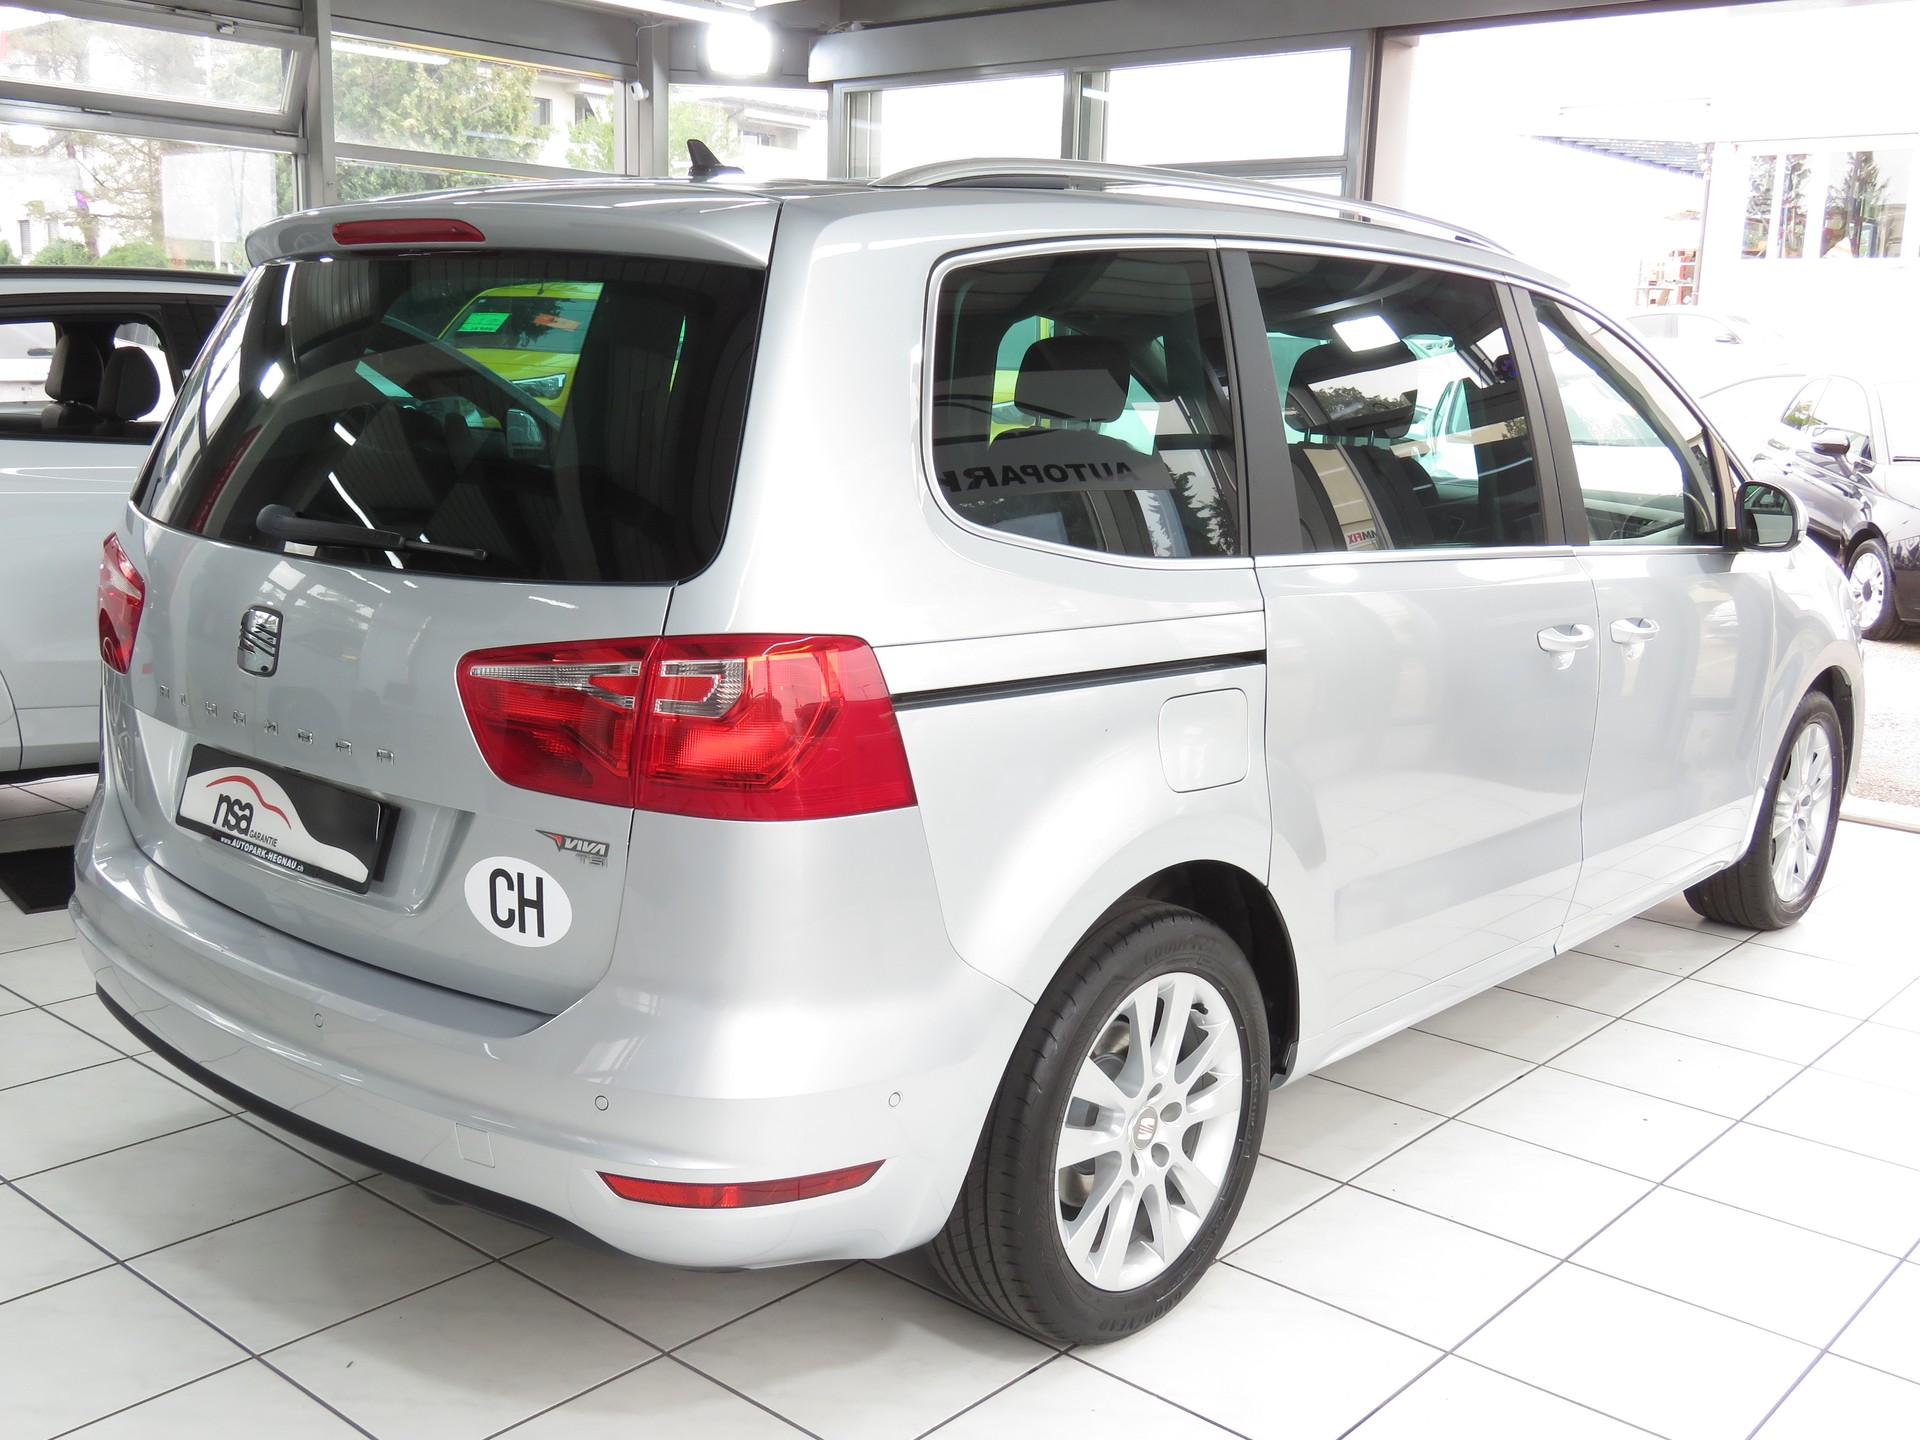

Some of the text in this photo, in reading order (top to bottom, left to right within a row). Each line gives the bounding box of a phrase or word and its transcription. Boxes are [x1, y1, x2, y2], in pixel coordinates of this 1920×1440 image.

[212, 793, 254, 837] nsa
[220, 836, 304, 873] www.AUTOPARK-HEGNAU.ch
[249, 829, 279, 848] GARANTIE
[564, 837, 607, 856] VIVA
[489, 867, 545, 938] CH
